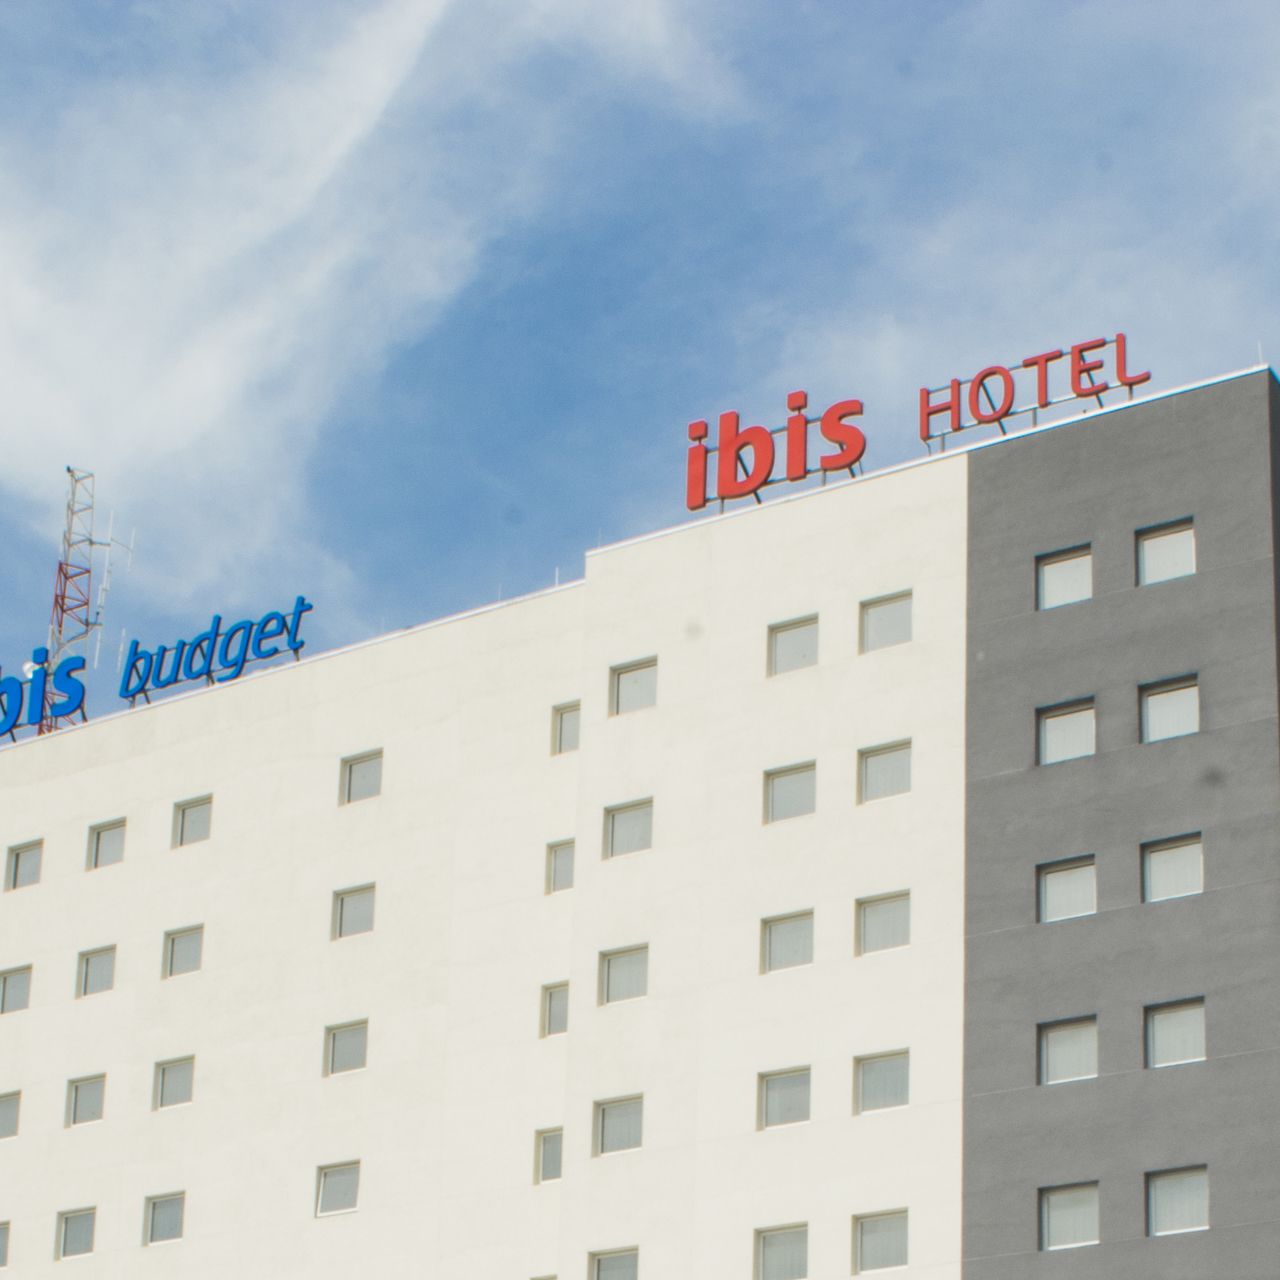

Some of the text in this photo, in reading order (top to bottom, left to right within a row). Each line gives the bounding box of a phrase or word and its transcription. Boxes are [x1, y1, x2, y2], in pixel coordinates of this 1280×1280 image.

[687, 333, 1151, 510] ibis HOTEL
[119, 595, 313, 698] budget
